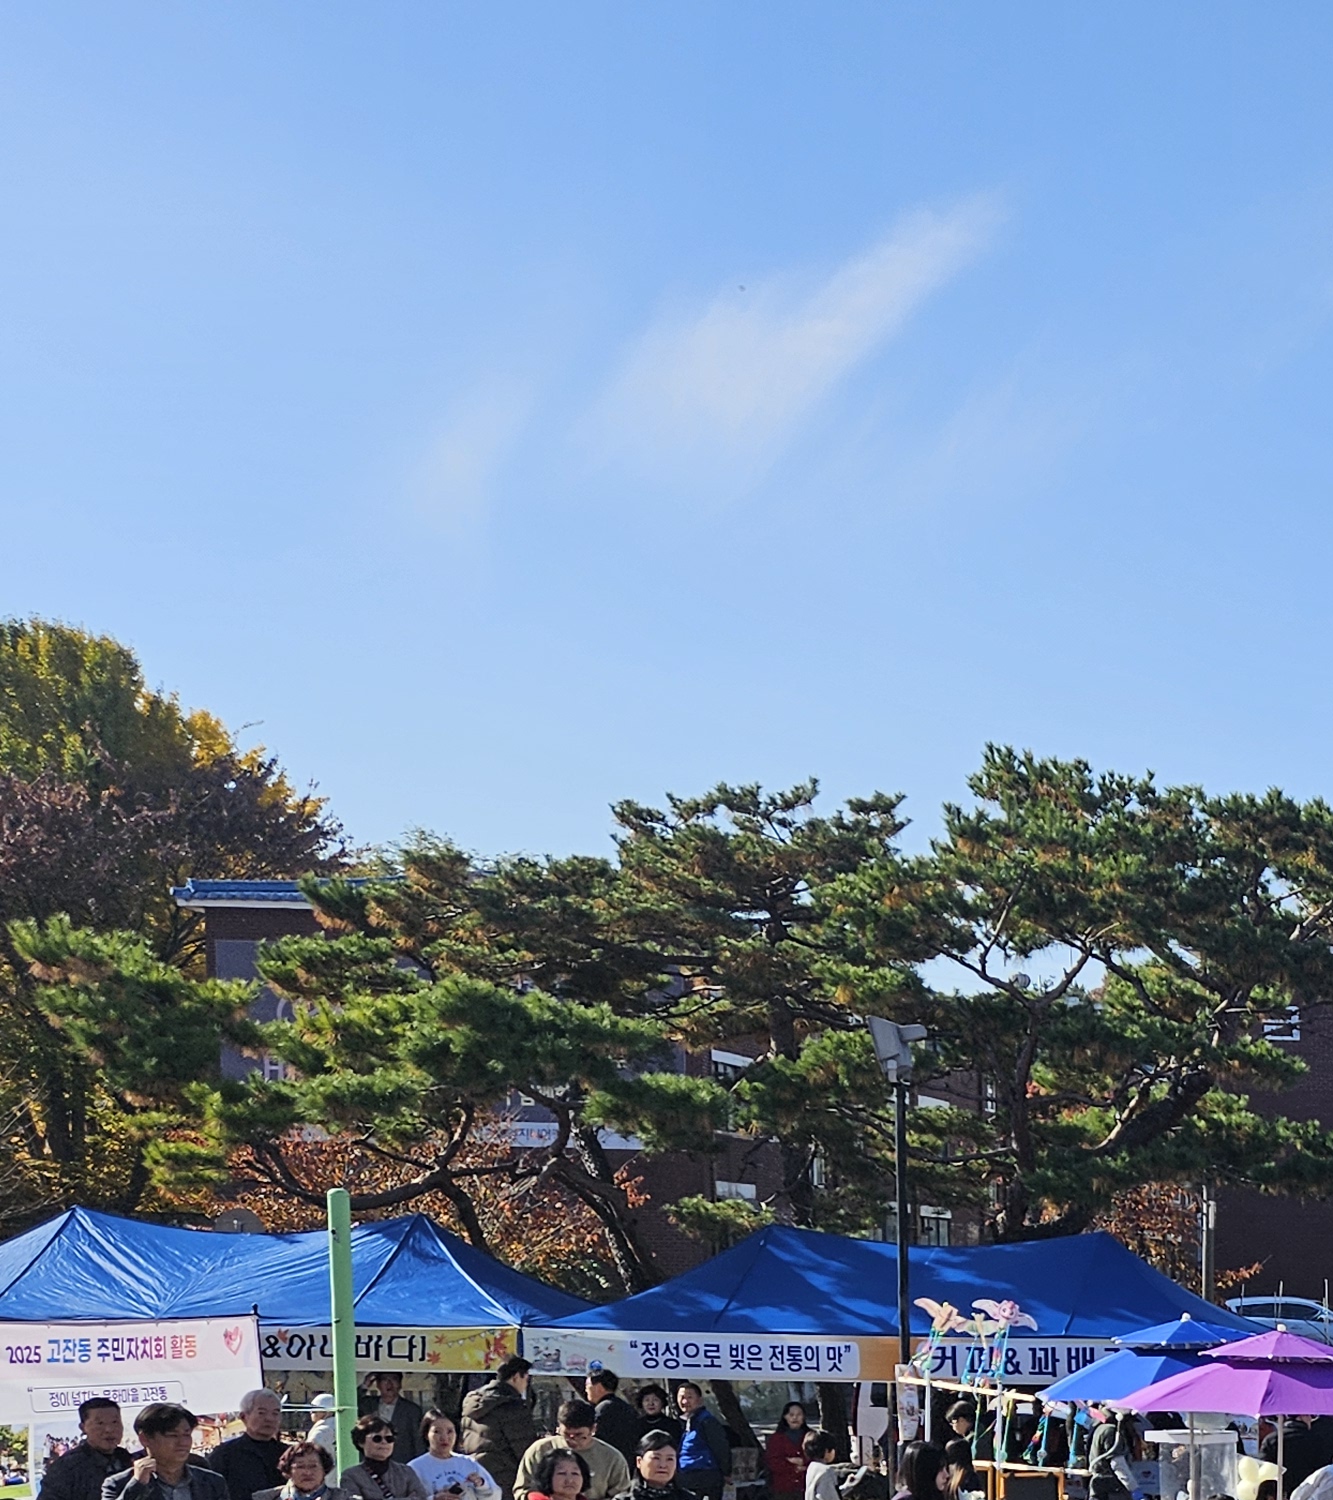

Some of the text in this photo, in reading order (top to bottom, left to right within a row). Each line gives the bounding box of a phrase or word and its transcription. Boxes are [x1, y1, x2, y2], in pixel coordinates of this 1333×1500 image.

[5, 1334, 197, 1364] 2025 고잔동 주민자치회 활동
[729, 1344, 763, 1371] 빚은
[768, 1344, 820, 1373] 전통의
[49, 1391, 70, 1407] 정이
[141, 1386, 168, 1402] 고잔동
